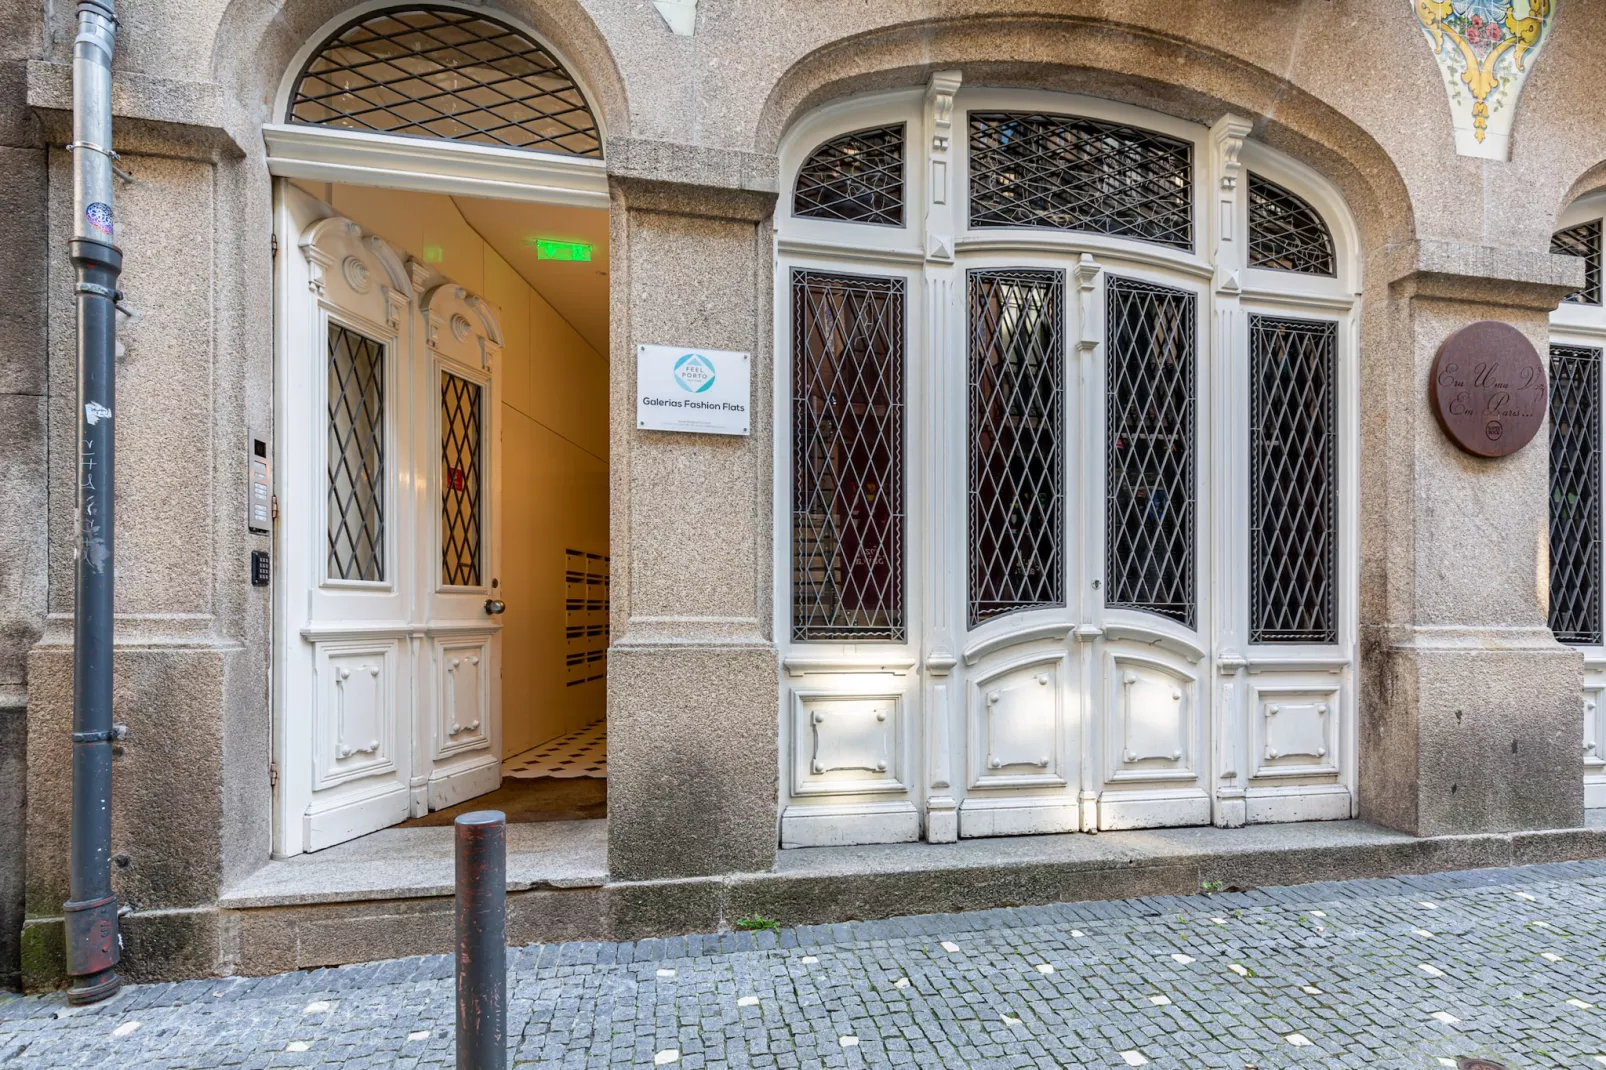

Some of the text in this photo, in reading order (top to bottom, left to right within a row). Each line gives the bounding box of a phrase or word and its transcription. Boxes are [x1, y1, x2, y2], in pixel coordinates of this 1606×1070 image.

[681, 372, 708, 380] PORTO
[1438, 362, 1464, 388] Era
[1474, 362, 1509, 388] Uma
[642, 397, 745, 412] Galerias Fashion Flats
[1449, 391, 1473, 416] Em
